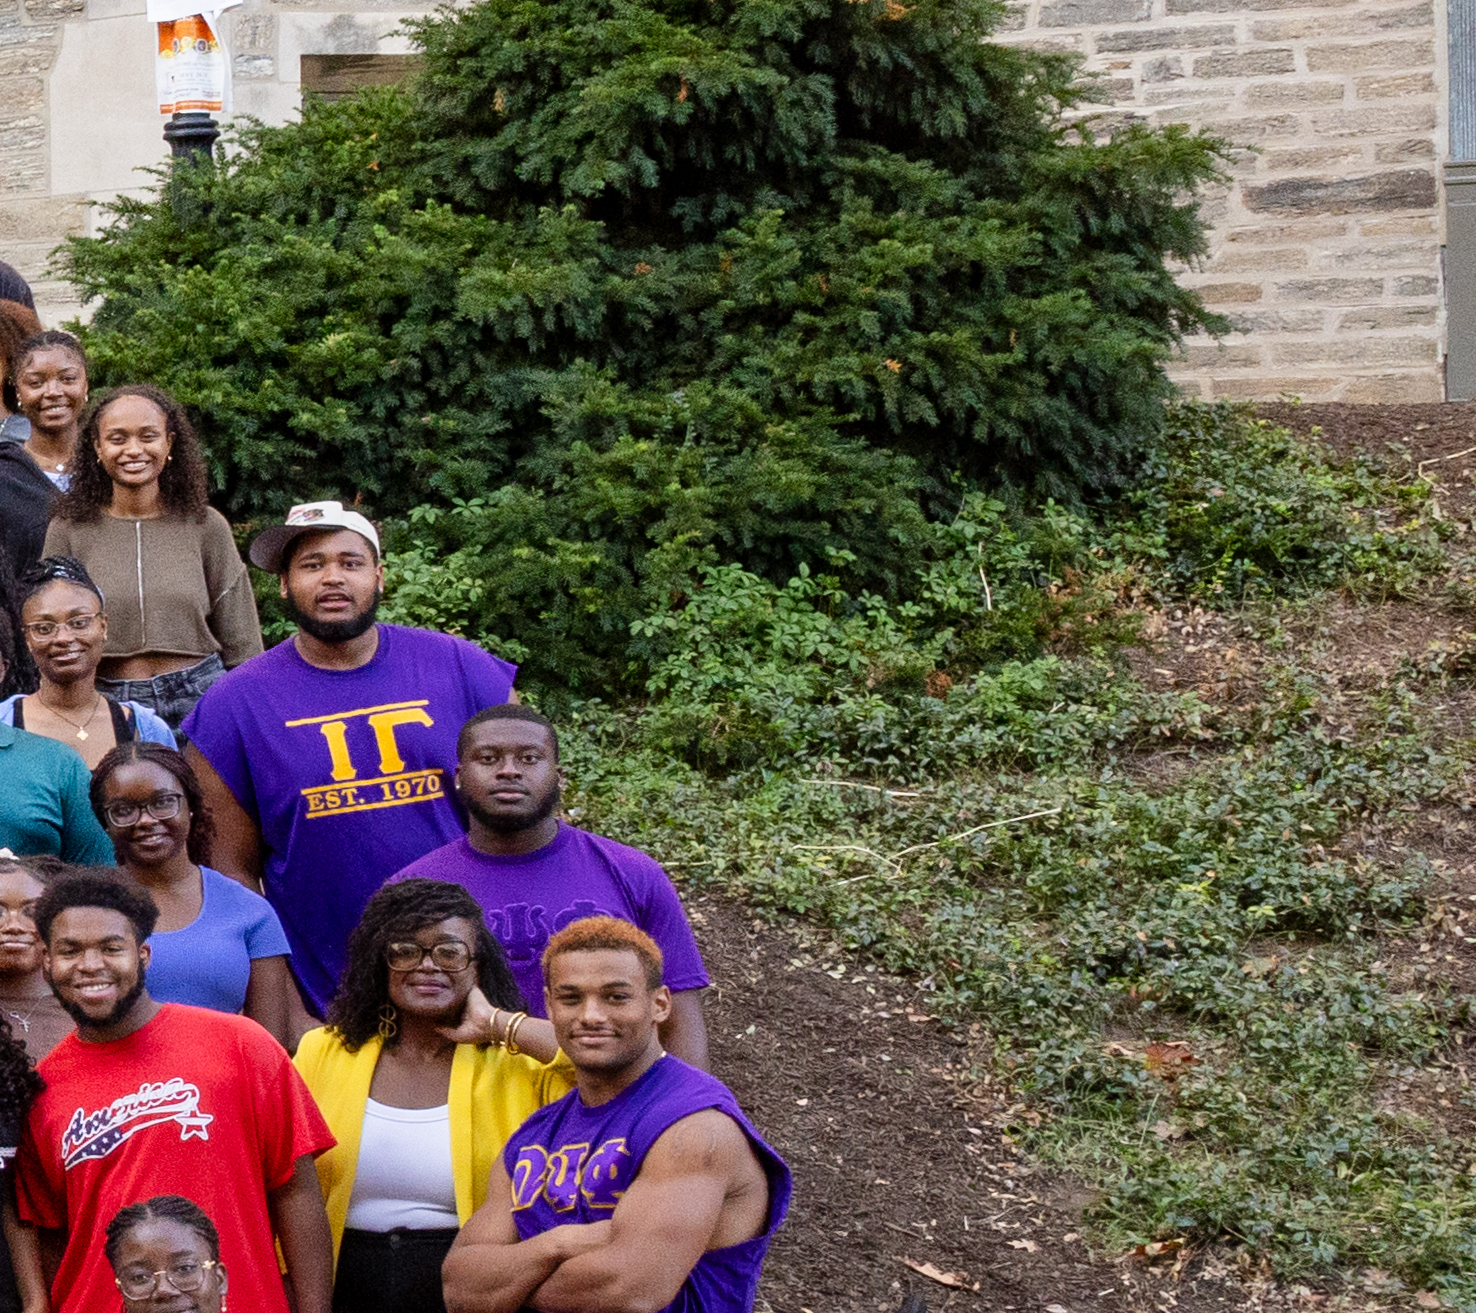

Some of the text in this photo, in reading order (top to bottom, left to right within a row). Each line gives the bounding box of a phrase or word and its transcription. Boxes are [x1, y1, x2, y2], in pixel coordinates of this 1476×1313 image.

[308, 774, 441, 812] EST. 1970
[61, 1077, 199, 1159] American
